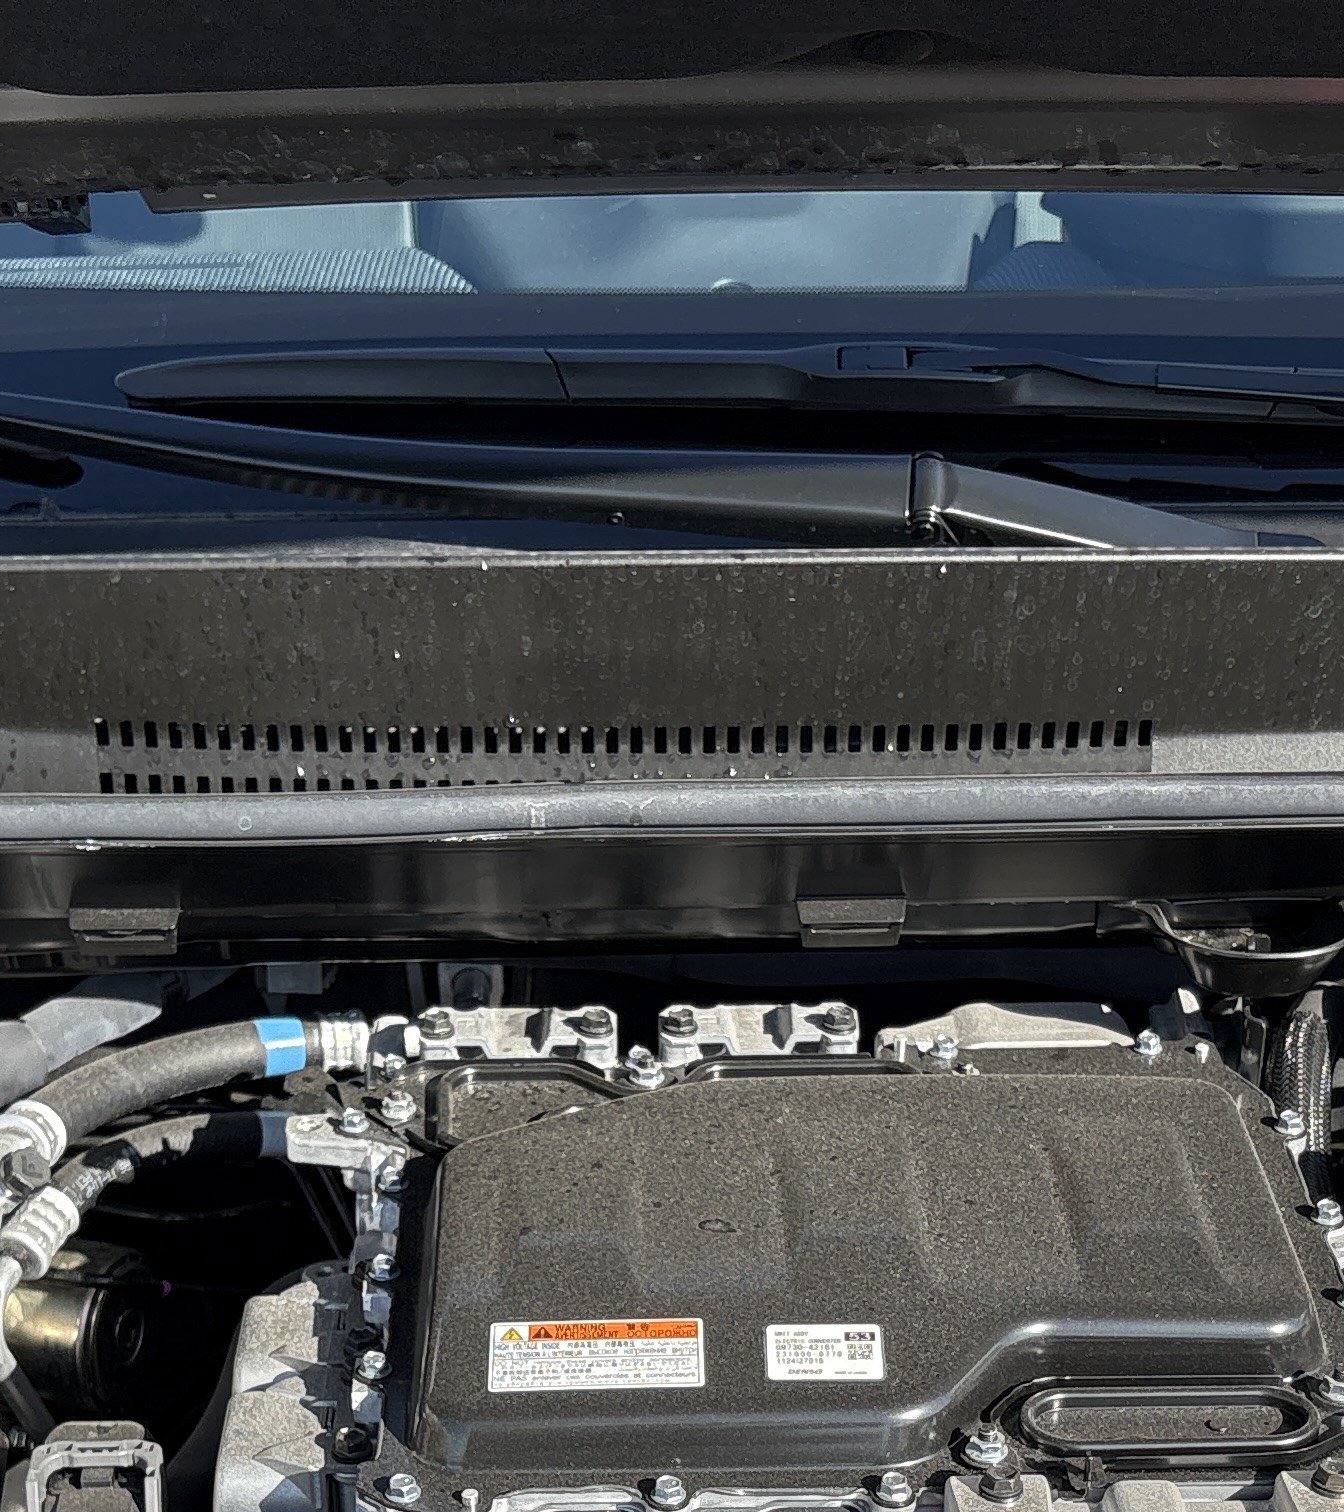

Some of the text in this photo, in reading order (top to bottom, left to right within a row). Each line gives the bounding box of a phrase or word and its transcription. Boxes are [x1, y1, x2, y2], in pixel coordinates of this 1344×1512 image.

[555, 1324, 606, 1332] WARNING
[627, 1329, 696, 1338] ОСТОРОЖНО
[848, 1332, 871, 1341] 53
